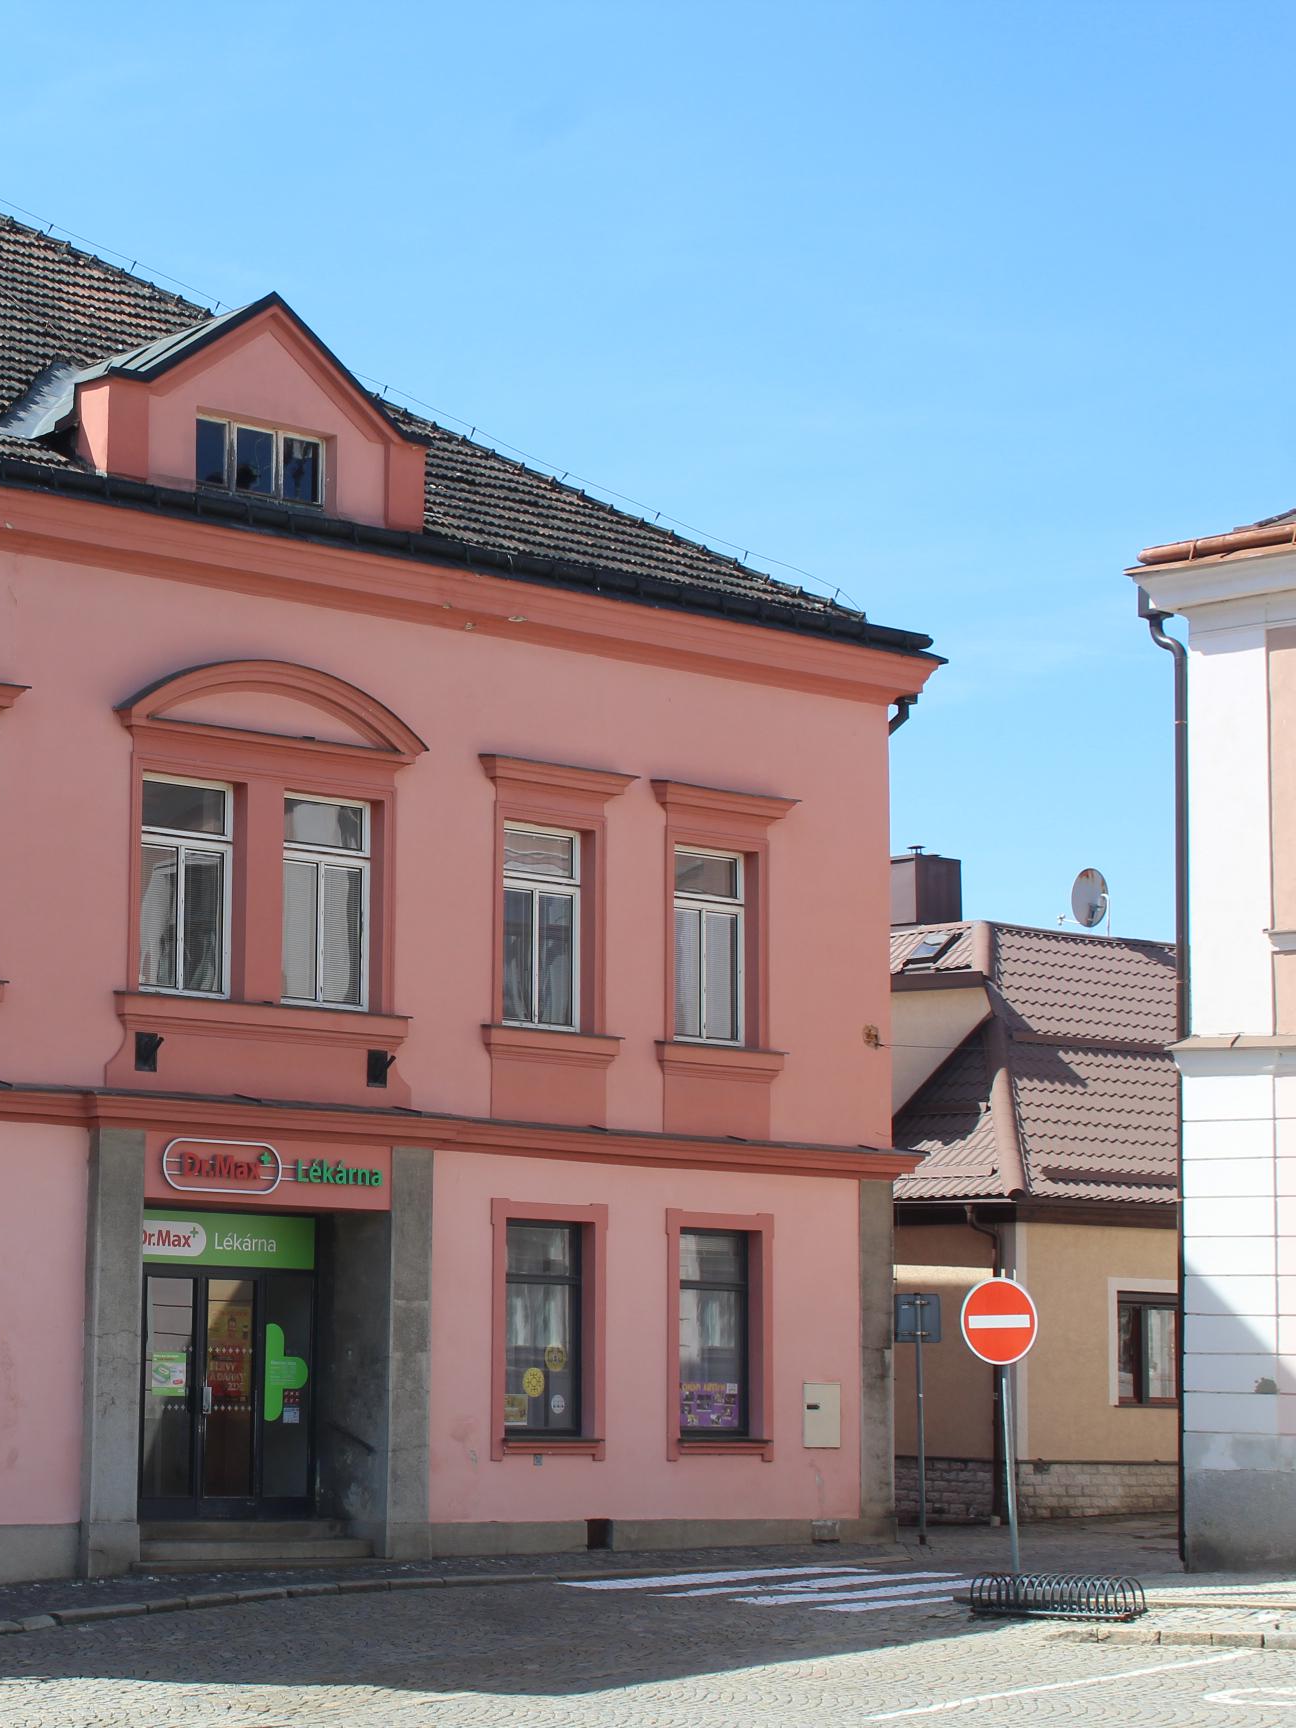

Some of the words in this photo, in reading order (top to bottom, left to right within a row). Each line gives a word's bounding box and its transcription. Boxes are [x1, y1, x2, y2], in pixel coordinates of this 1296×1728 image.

[182, 1151, 261, 1181] Dr.Max
[296, 1158, 384, 1187] Lékárna
[214, 1231, 277, 1253] Lékárna
